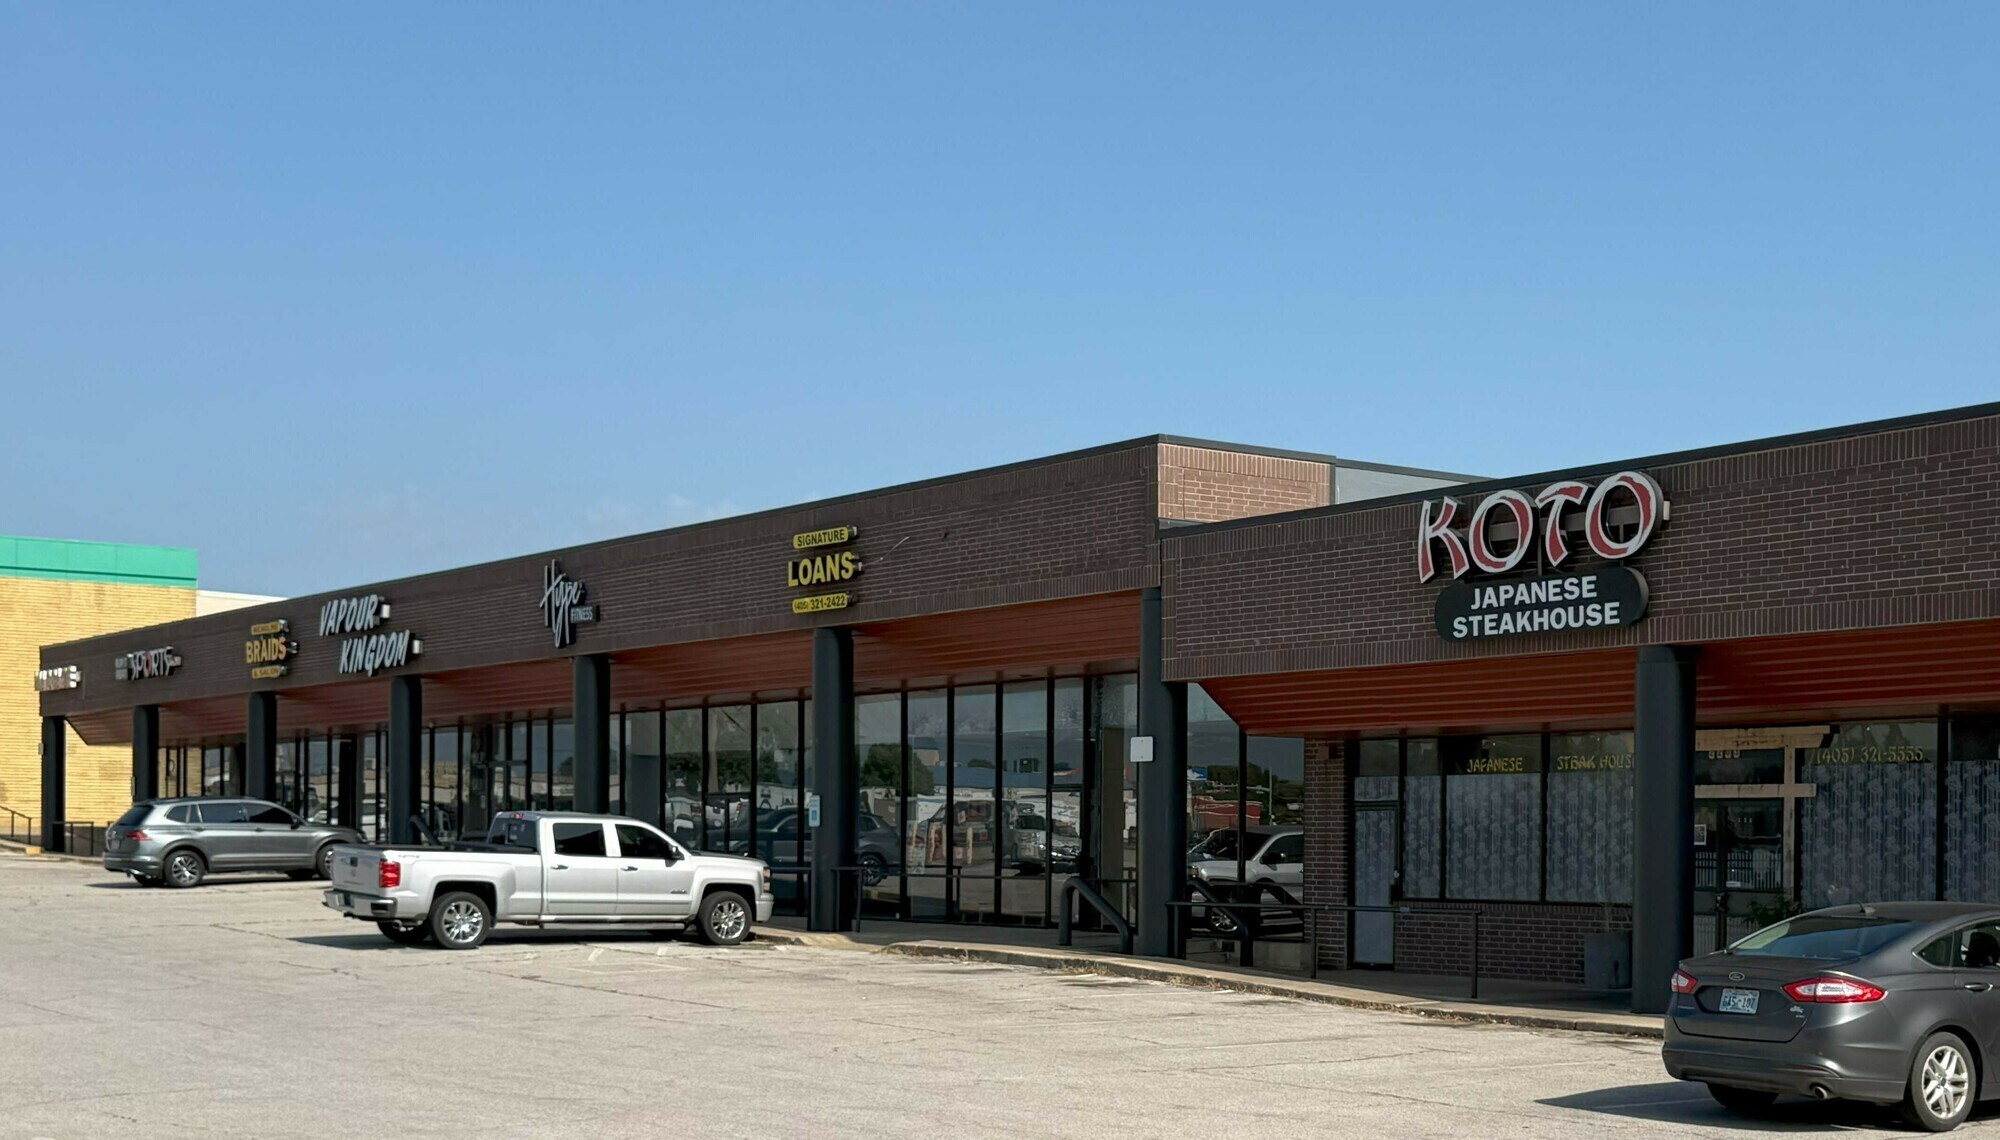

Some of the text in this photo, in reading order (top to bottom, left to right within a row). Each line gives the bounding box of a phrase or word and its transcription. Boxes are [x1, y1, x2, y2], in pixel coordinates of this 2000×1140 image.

[797, 529, 845, 547] SIGNATURE
[1418, 471, 1657, 584] KOTO
[788, 551, 854, 587] LOANS
[810, 595, 845, 610] 321-2422
[1471, 576, 1597, 610] JAPANESE
[320, 594, 379, 636] VAPOUR
[1453, 602, 1620, 638] STEAKHOUSE
[246, 636, 287, 664] BRAIDS
[340, 629, 409, 677] KINGDOM
[1467, 754, 1635, 773] JAPANESE STEAK HOUS
[1817, 748, 1855, 764] (405)
